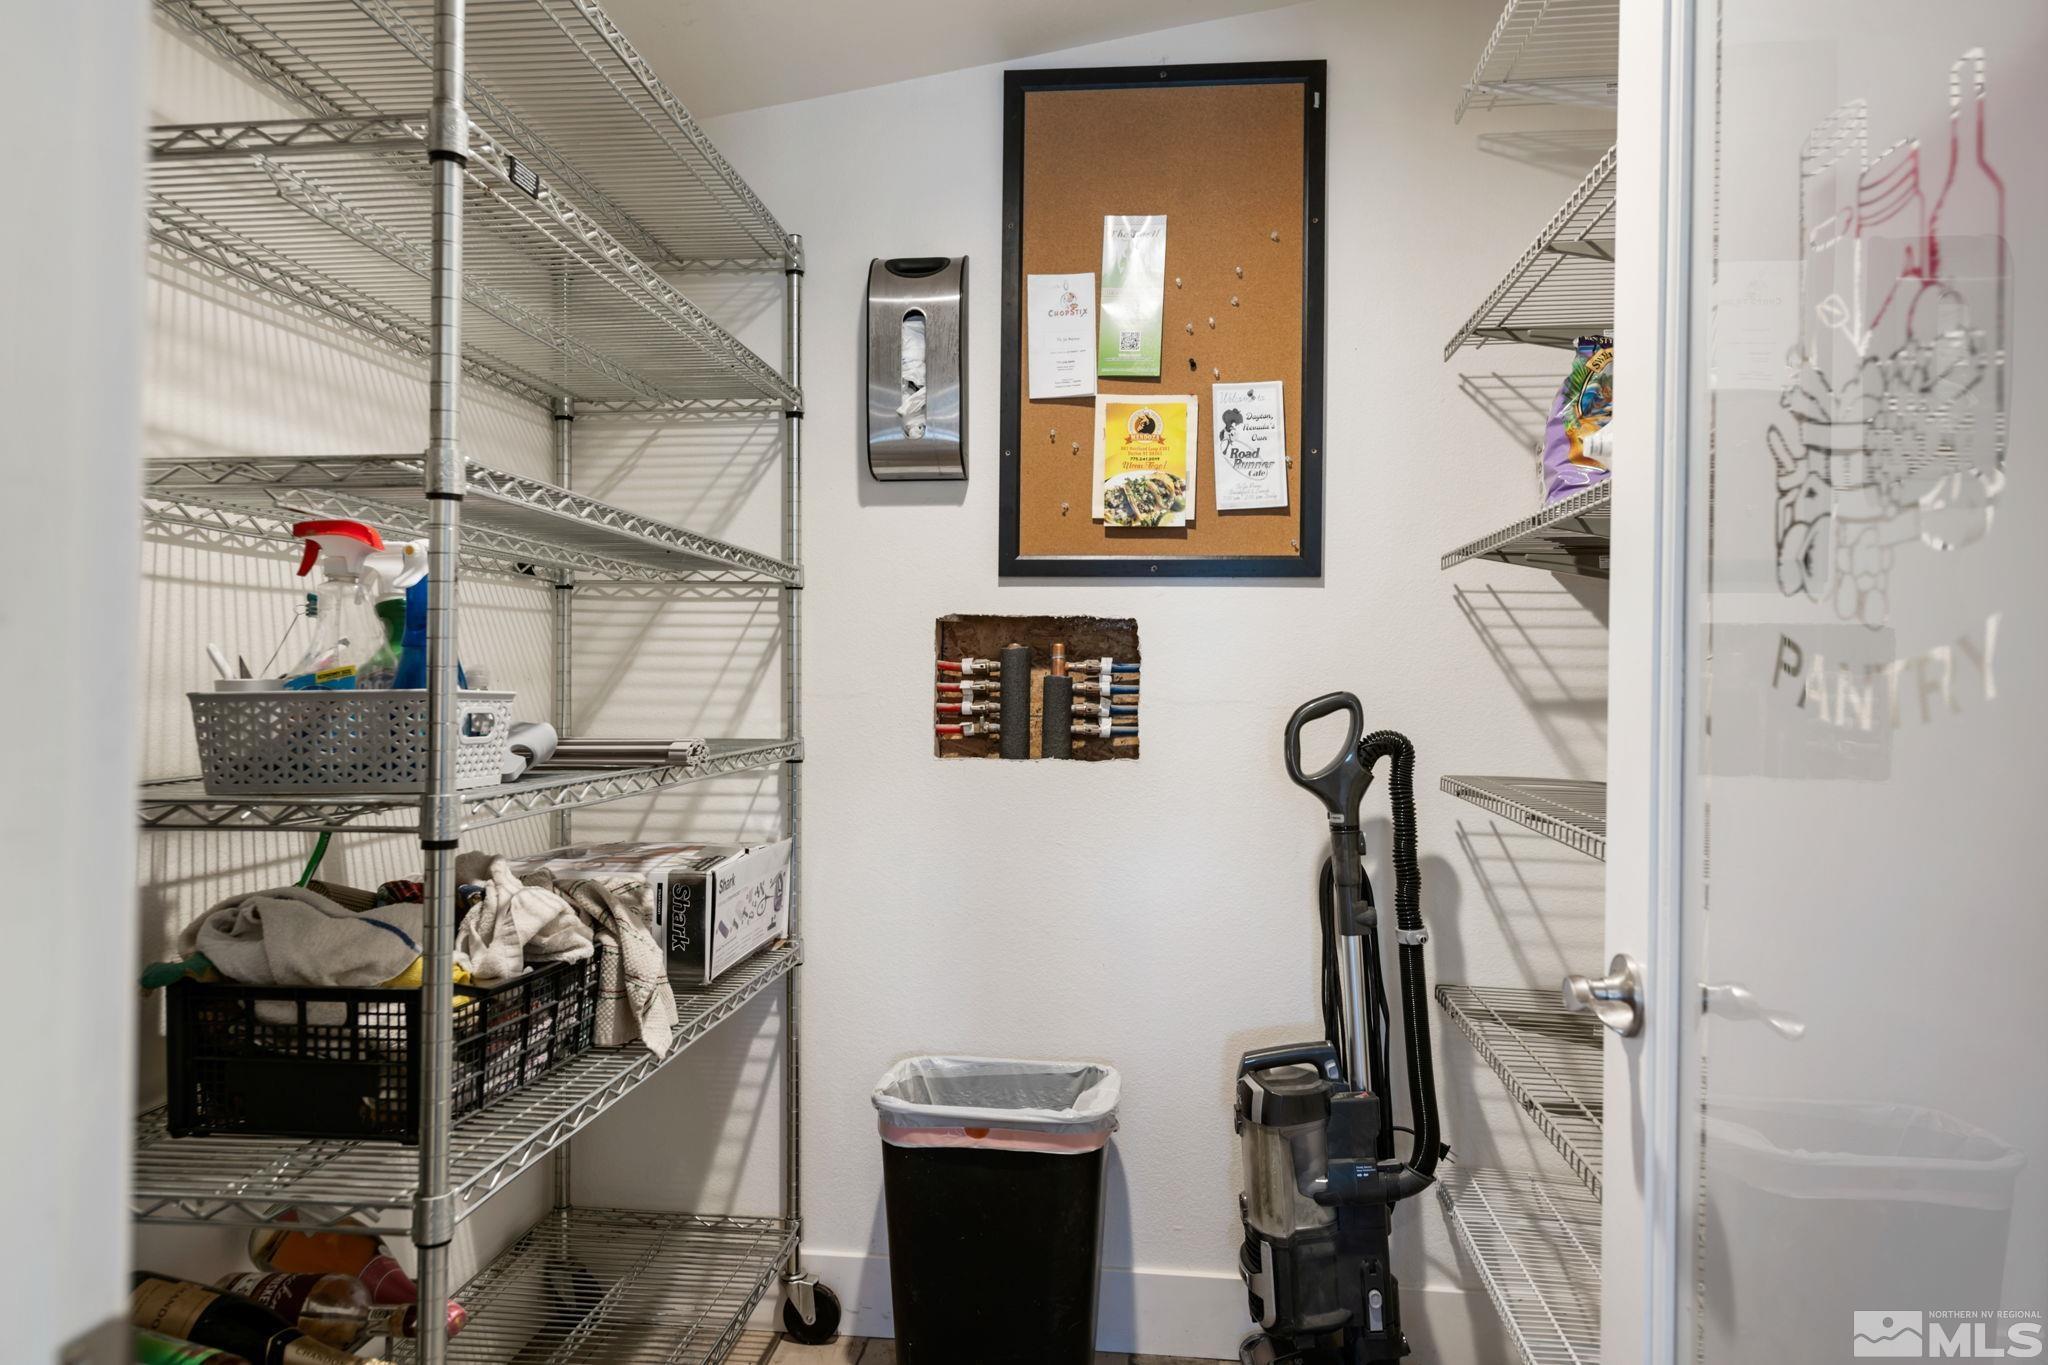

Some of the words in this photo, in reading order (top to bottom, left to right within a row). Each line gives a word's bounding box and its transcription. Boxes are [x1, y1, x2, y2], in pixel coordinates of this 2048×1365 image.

[1048, 308, 1088, 317] CHOPSTIX
[1230, 448, 1260, 459] Road
[1233, 459, 1275, 469] Runner
[1772, 611, 2001, 730] PANTRY
[719, 873, 735, 894] Shark
[672, 883, 691, 952] Shark
